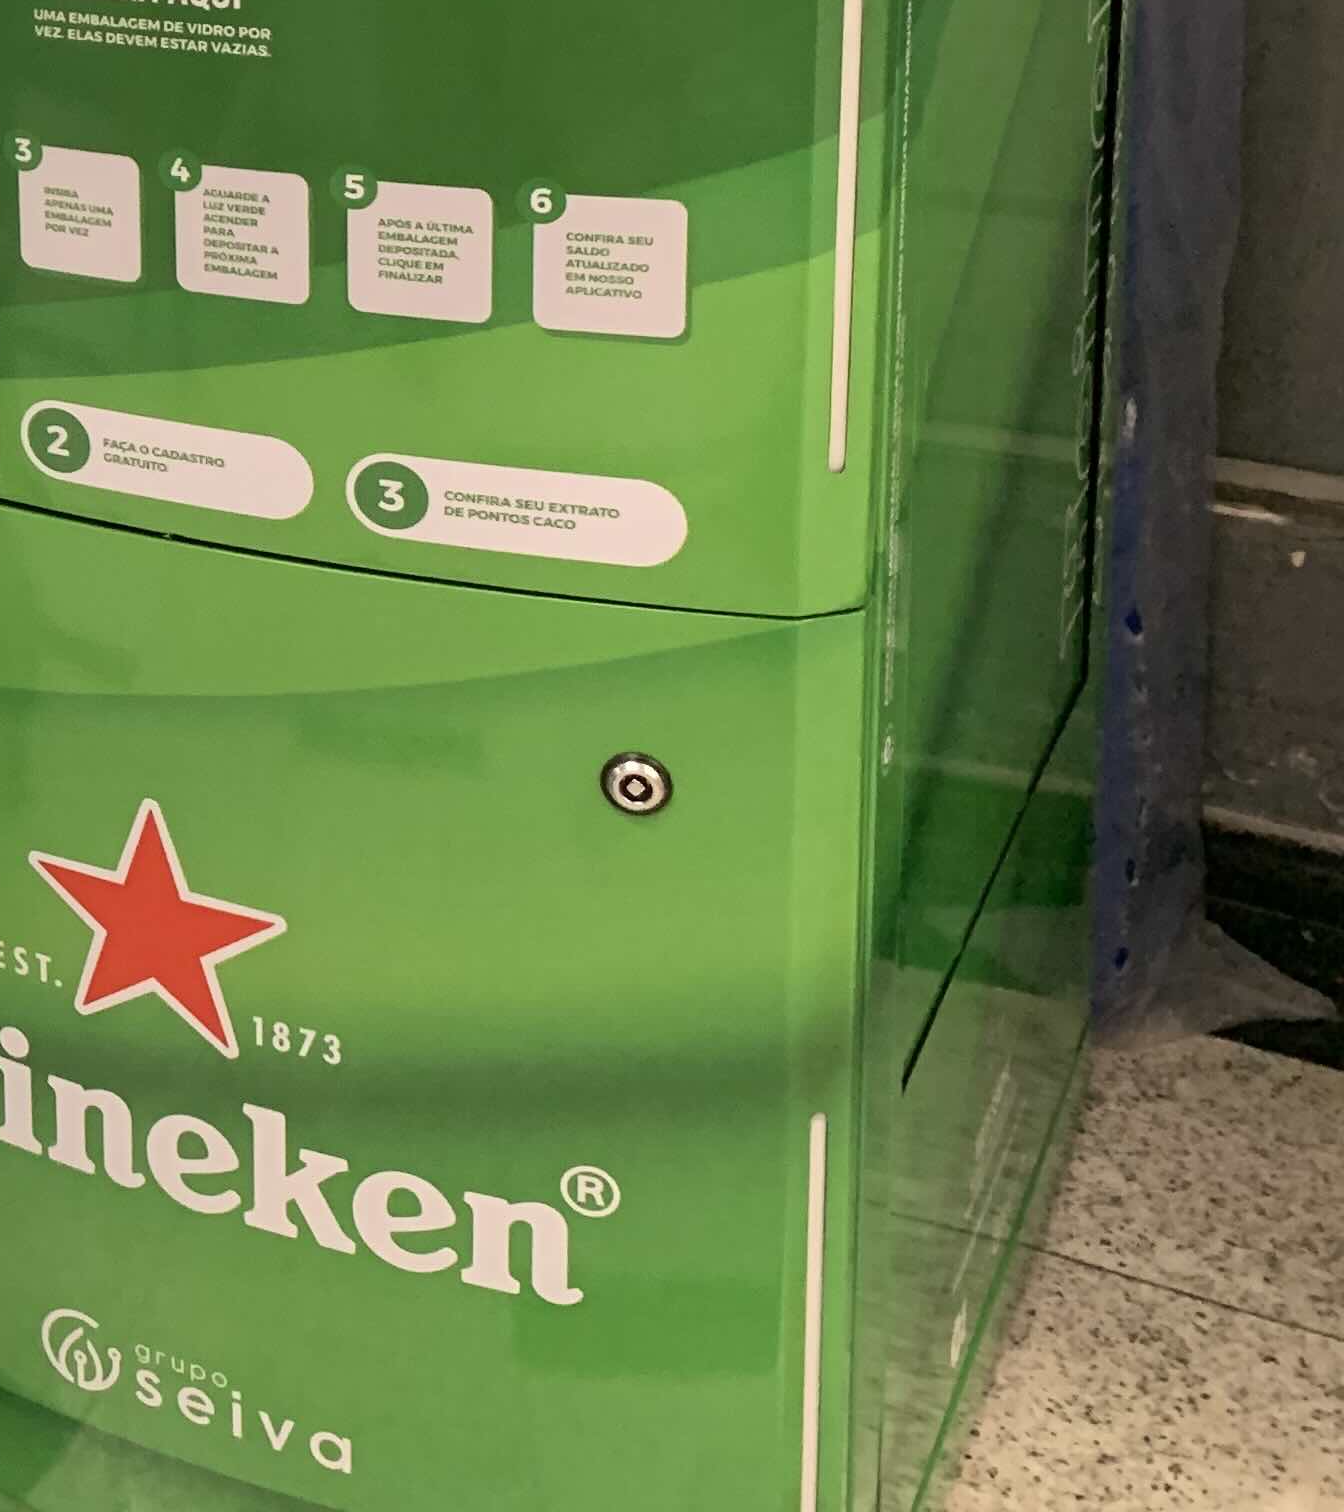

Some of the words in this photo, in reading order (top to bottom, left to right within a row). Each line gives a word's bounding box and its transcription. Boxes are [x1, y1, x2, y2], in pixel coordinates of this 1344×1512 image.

[33, 8, 66, 23] UMA
[69, 12, 161, 32] EMBALAGEM
[163, 20, 184, 34] DE
[186, 22, 236, 38] VIDRO
[238, 26, 272, 40] POR
[68, 29, 103, 42] ELAS
[106, 32, 157, 48] DEVEM
[160, 37, 208, 52] ESTAR
[210, 41, 272, 57] VAZIAS.
[15, 137, 32, 162] 3
[171, 157, 190, 182] 4
[344, 174, 365, 199] 5
[203, 189, 259, 203] AGUARDE
[261, 194, 270, 204] A
[530, 188, 552, 214] 6
[45, 198, 87, 211] APENAS
[88, 205, 114, 216] UMA
[203, 201, 224, 211] LUZ
[226, 204, 266, 216] VERDE
[45, 210, 112, 228] EMBALAGEM
[203, 213, 258, 227] ACENDER
[378, 216, 412, 229] APÓS
[414, 220, 423, 230] A
[426, 220, 474, 234] ÚLTIMA
[45, 223, 66, 233] POR
[69, 227, 89, 237] VEZ
[203, 225, 235, 237] PARA
[378, 231, 458, 246] EMBALAGEM
[566, 232, 625, 244] CONFIRA
[627, 236, 654, 246] SEU
[203, 238, 268, 254] DEPOSITAR
[270, 246, 279, 256] A
[566, 246, 610, 257] SALDO
[204, 263, 278, 280] EMBALAGEM
[378, 257, 423, 270] CLIQUE
[425, 261, 444, 271] EM
[566, 259, 650, 273] ATUALIZADO
[378, 270, 443, 284] FINALIZAR
[566, 272, 585, 282] EM
[588, 275, 634, 285] NOSSO
[566, 286, 642, 299] APLICATIVO
[47, 425, 70, 457] 2
[103, 438, 136, 454] FAÇA
[139, 444, 149, 455] O
[152, 447, 225, 468] CADASTRO
[377, 478, 405, 512] 3
[444, 490, 512, 509] CONFIRA
[514, 499, 545, 511] SEU
[548, 501, 621, 519] EXTRATO
[444, 506, 464, 517] DE
[467, 509, 530, 526] PONTOS
[533, 516, 576, 530] CACO
[252, 1015, 342, 1065] 1873
[134, 1344, 228, 1388] grupo
[135, 1369, 353, 1474] seiva
